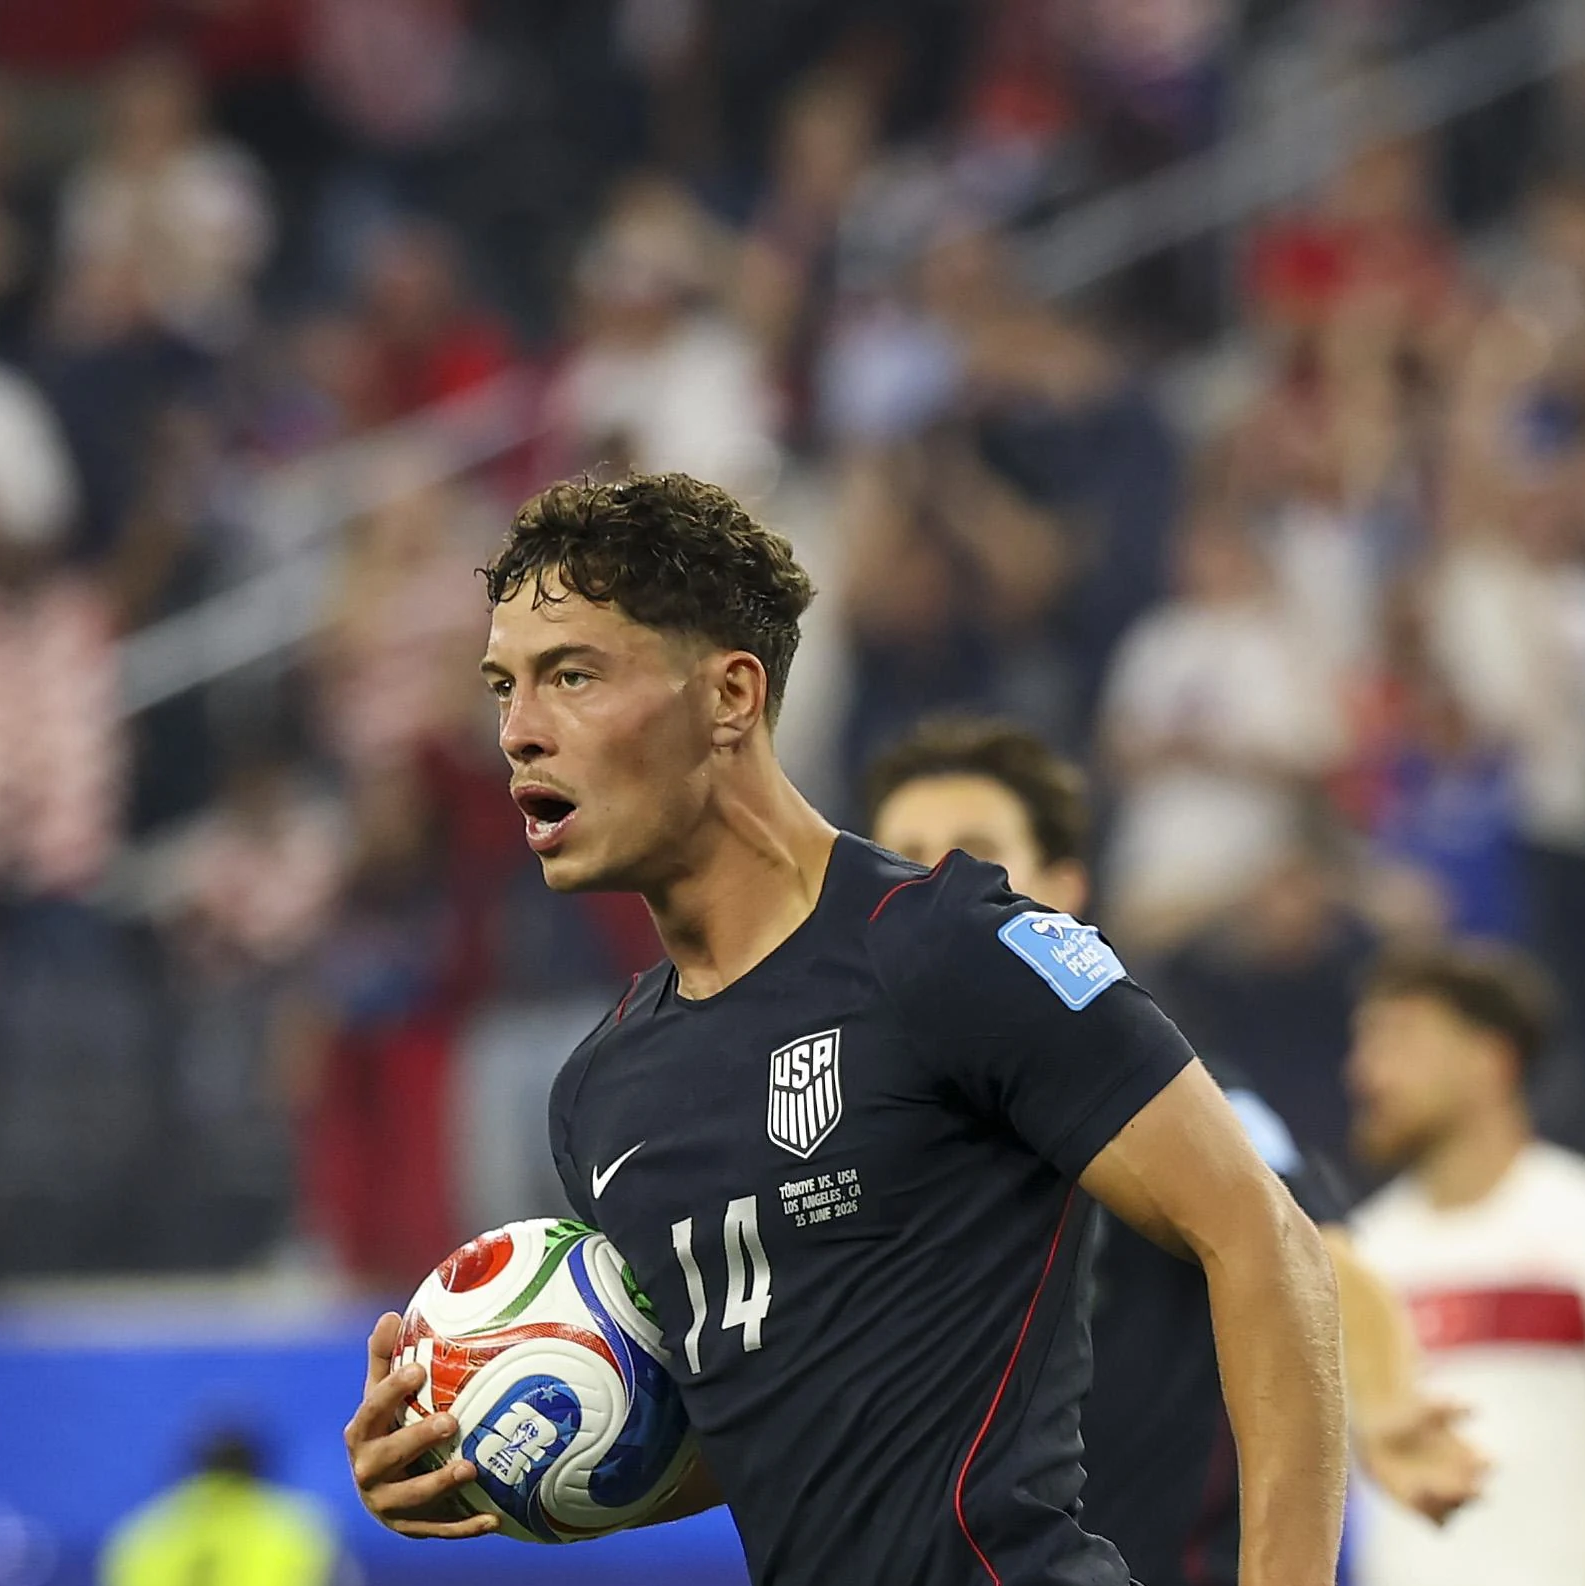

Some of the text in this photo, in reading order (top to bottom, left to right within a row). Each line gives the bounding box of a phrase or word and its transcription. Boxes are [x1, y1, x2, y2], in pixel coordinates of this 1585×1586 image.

[1066, 945, 1103, 977] PEACE
[774, 1036, 834, 1090] USA
[817, 1174, 834, 1190] VS.
[837, 1168, 858, 1185] USA
[783, 1183, 862, 1215] LOS ANGELES, CA
[795, 1199, 858, 1228] 25 JUNE 2026
[671, 1195, 772, 1375] 14
[488, 1456, 509, 1477] FIFA
